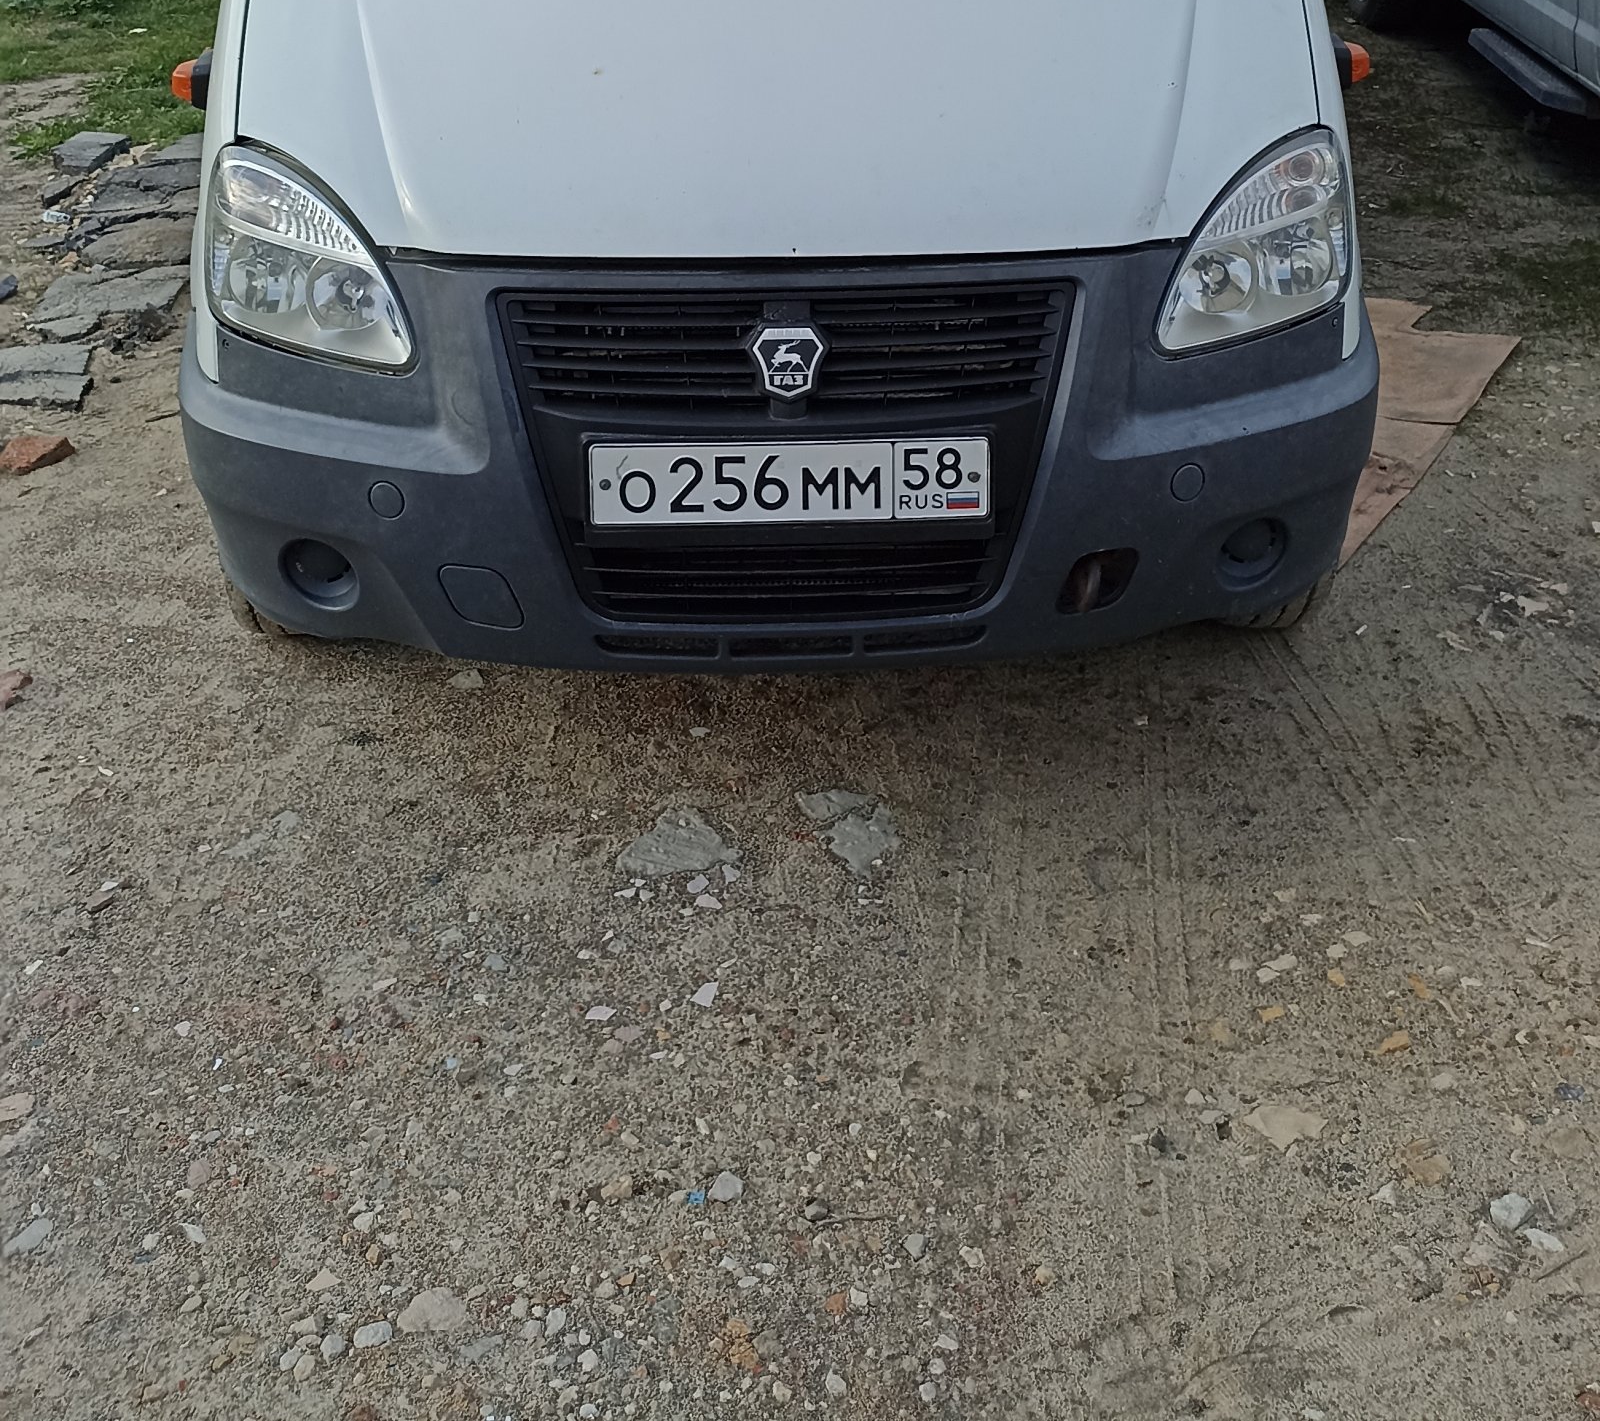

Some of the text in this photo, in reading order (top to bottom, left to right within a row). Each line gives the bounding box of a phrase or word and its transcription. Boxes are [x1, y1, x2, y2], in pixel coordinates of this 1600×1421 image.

[774, 375, 804, 386] ГАЗ
[903, 447, 962, 490] 58
[899, 493, 944, 510] RUS
